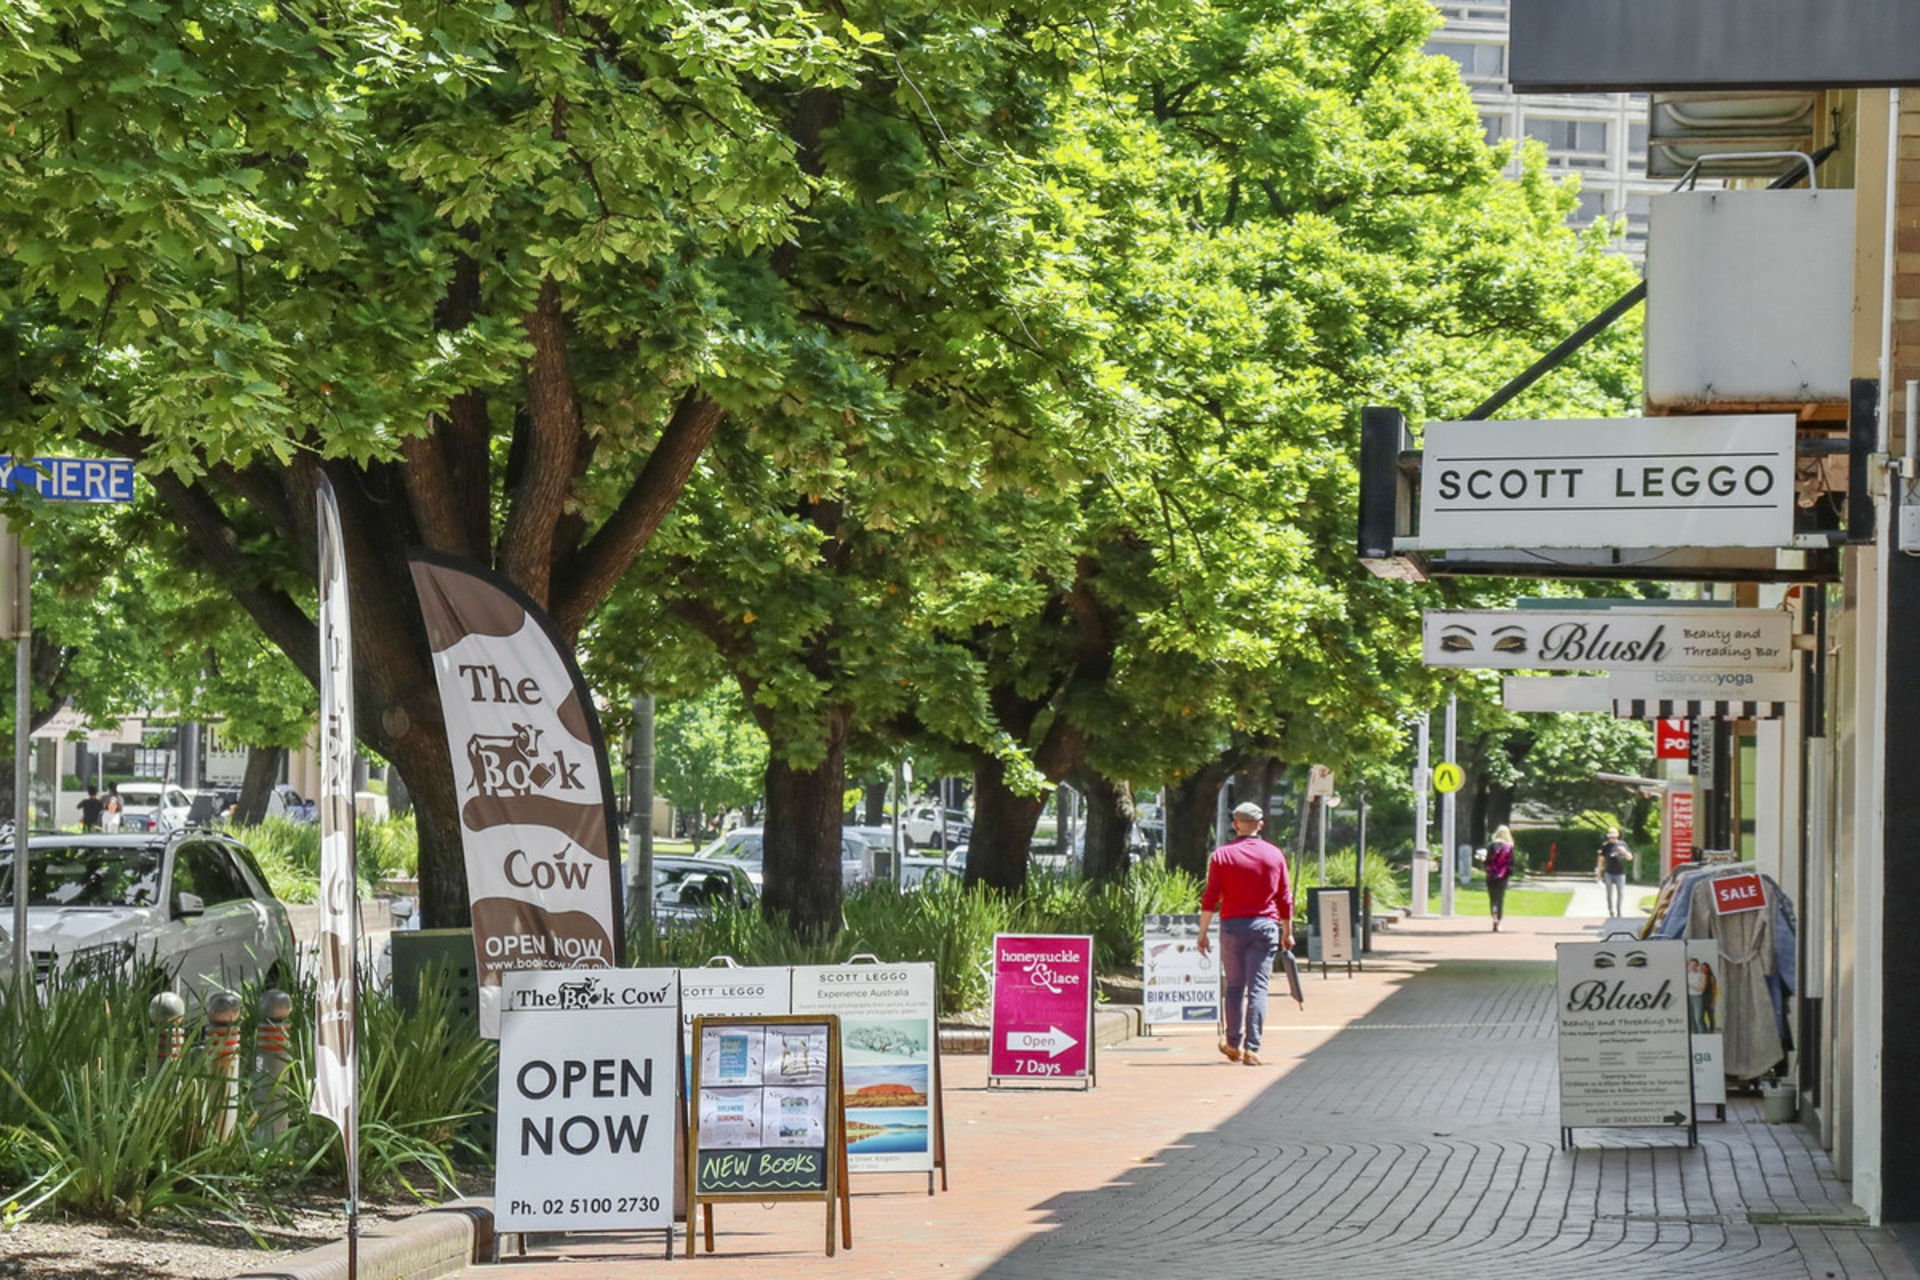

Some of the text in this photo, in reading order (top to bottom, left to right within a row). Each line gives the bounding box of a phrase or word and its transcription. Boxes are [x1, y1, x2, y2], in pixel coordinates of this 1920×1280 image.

[36, 461, 130, 498] HERE
[1438, 464, 1775, 500] SCOTT LEGGO
[1539, 622, 1672, 663] Blush
[1683, 628, 1762, 643] Beauty and
[1683, 646, 1780, 661] Threading Bar
[459, 664, 543, 706] The
[1701, 720, 1712, 779] SYMMETR
[503, 848, 593, 891] Cow
[1720, 884, 1758, 902] SALE
[485, 934, 603, 959] OPEN NOW
[1001, 949, 1080, 972] honeysuckle
[819, 971, 908, 983] SCOTT LEGGO
[1053, 971, 1080, 985] lace
[516, 990, 556, 1007] The
[621, 987, 667, 1005] Cow
[682, 986, 765, 998] COTT LEGGO
[817, 987, 910, 1000] Experience Australia
[1146, 989, 1216, 1003] BIRKENSTOCK
[1567, 979, 1675, 1012] Blush
[1562, 1018, 1596, 1030] Beauty
[1597, 1018, 1615, 1028] and
[1618, 1018, 1666, 1029] Threading
[1022, 1034, 1056, 1048] Open
[1015, 1060, 1024, 1073] 7
[1027, 1059, 1061, 1076] Days
[516, 1058, 653, 1100] OPEN
[520, 1114, 650, 1156] NOW
[702, 1153, 817, 1180] NEW BOOKS
[510, 1196, 660, 1216] Ph. 02 5100 2730
